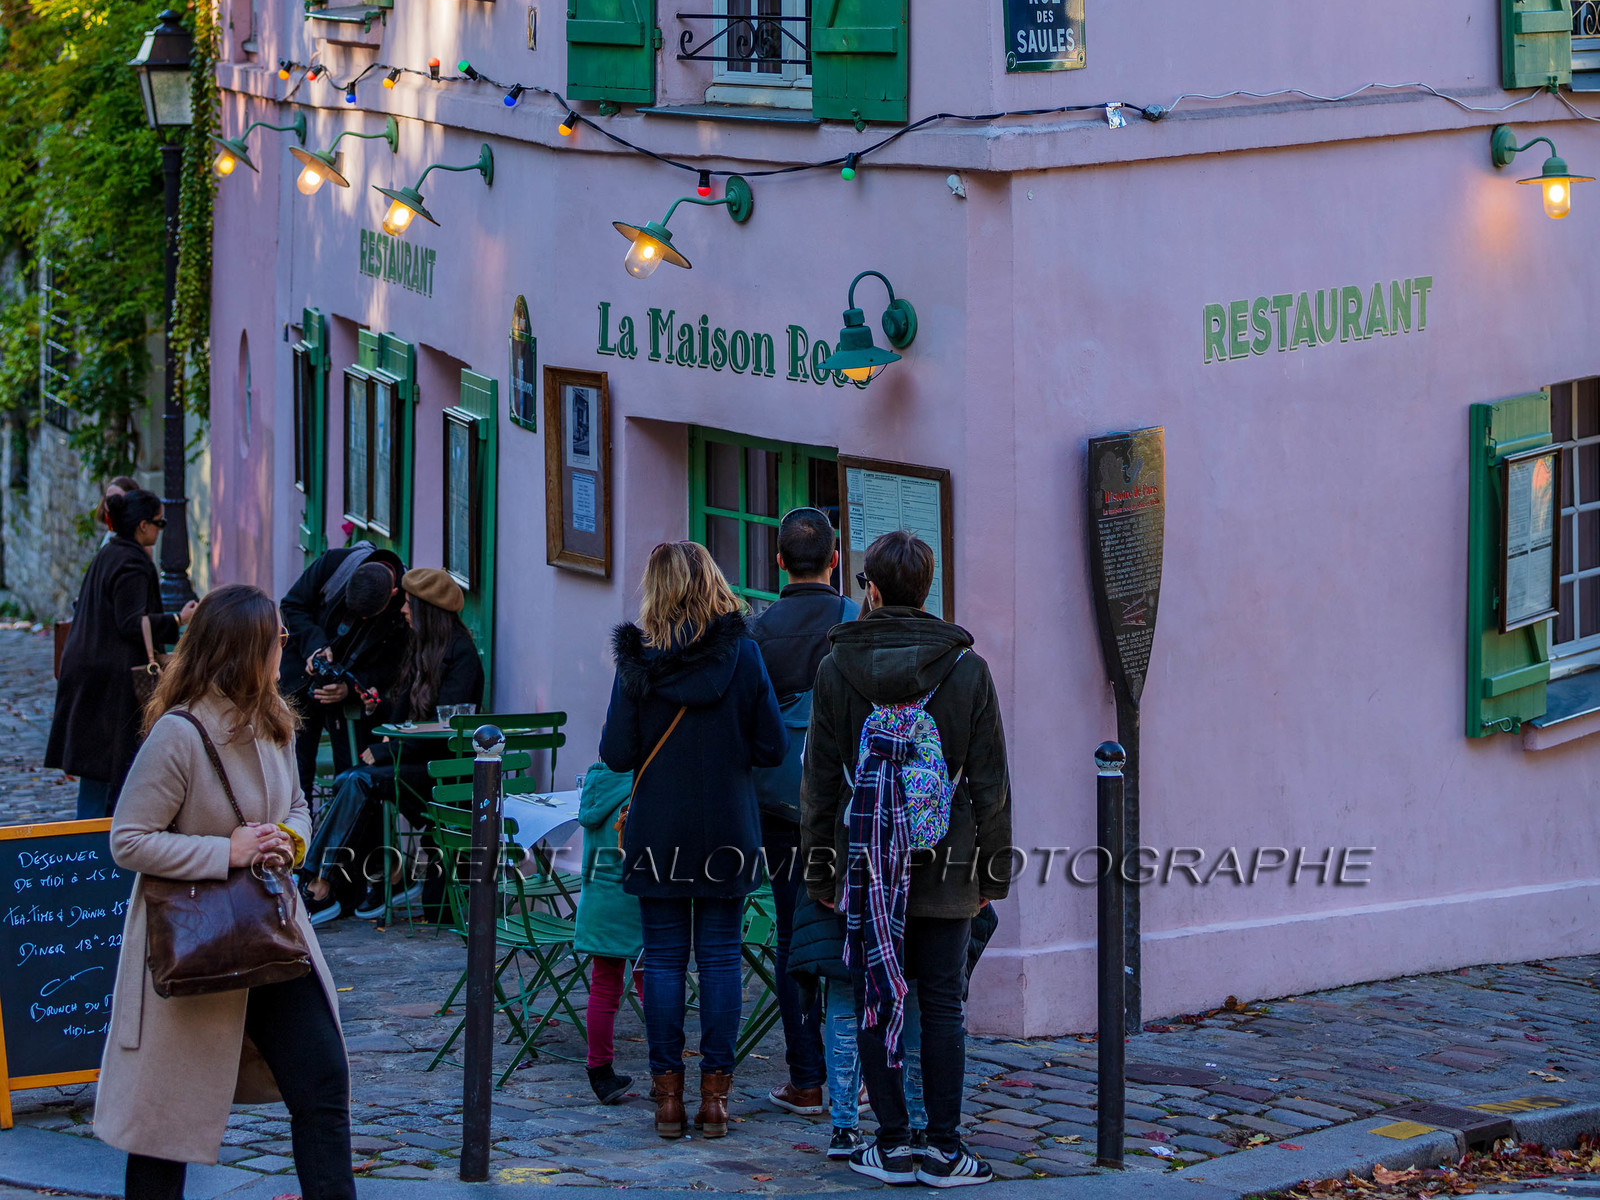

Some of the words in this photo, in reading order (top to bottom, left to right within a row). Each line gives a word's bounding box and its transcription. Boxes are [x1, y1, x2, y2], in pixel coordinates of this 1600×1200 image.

[1036, 10, 1054, 23] DES
[1017, 28, 1075, 54] SAULES
[360, 228, 437, 299] RESTAURANT
[1203, 276, 1433, 365] RESTAURANT
[597, 301, 638, 360] La
[647, 307, 776, 377] Maison
[786, 324, 871, 390] Ro
[14, 878, 34, 893] DE
[30, 1002, 78, 1023] BRUNCH
